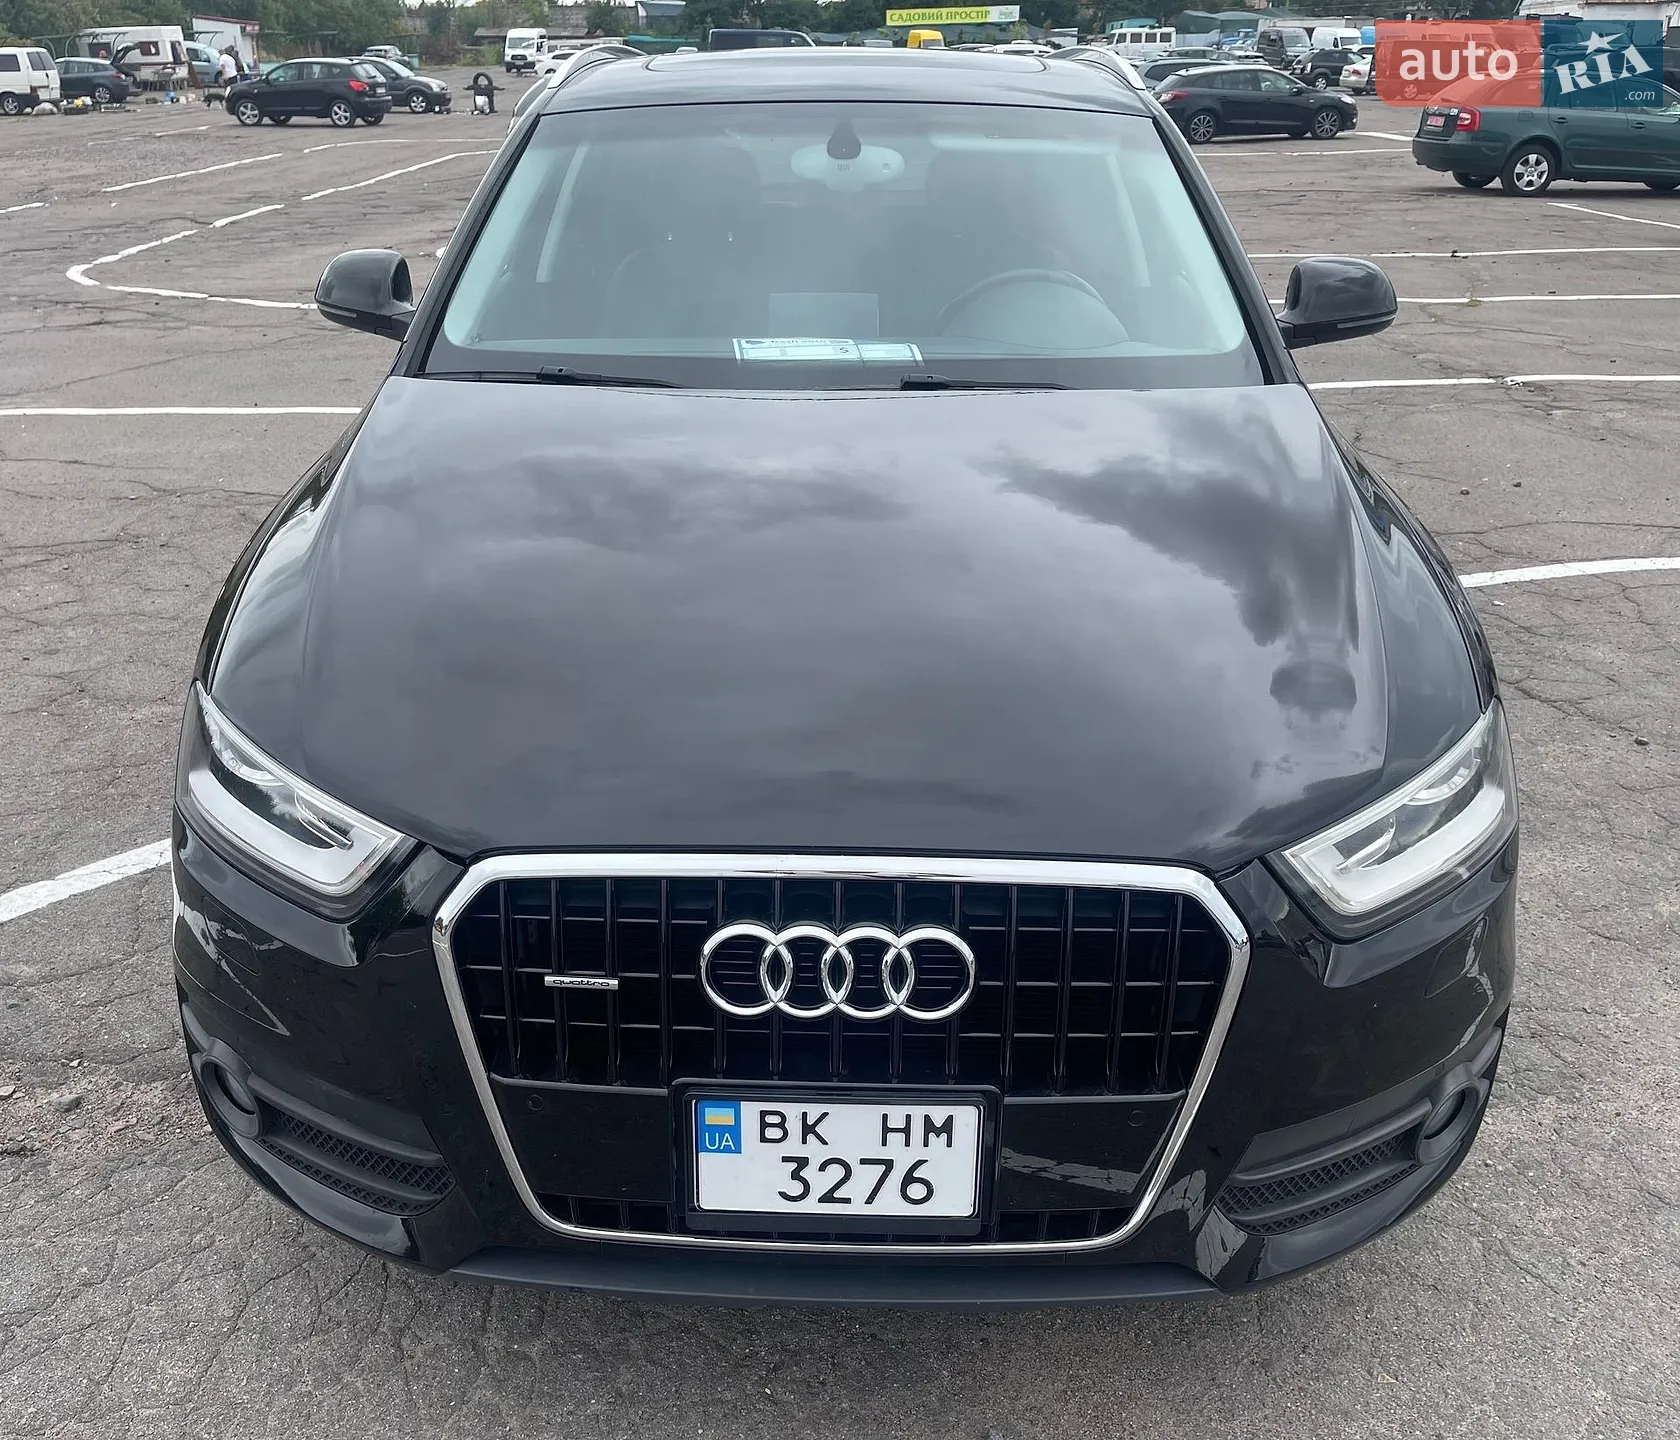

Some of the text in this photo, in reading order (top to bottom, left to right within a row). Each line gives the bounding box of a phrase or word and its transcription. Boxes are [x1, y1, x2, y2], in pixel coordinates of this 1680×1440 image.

[889, 10, 943, 22] САДОВИЙ
[946, 10, 991, 20] ПРОСТІР
[552, 979, 610, 987] quattro
[759, 1109, 954, 1148] BK HM
[705, 1132, 736, 1151] UA
[777, 1155, 935, 1205] 3276
